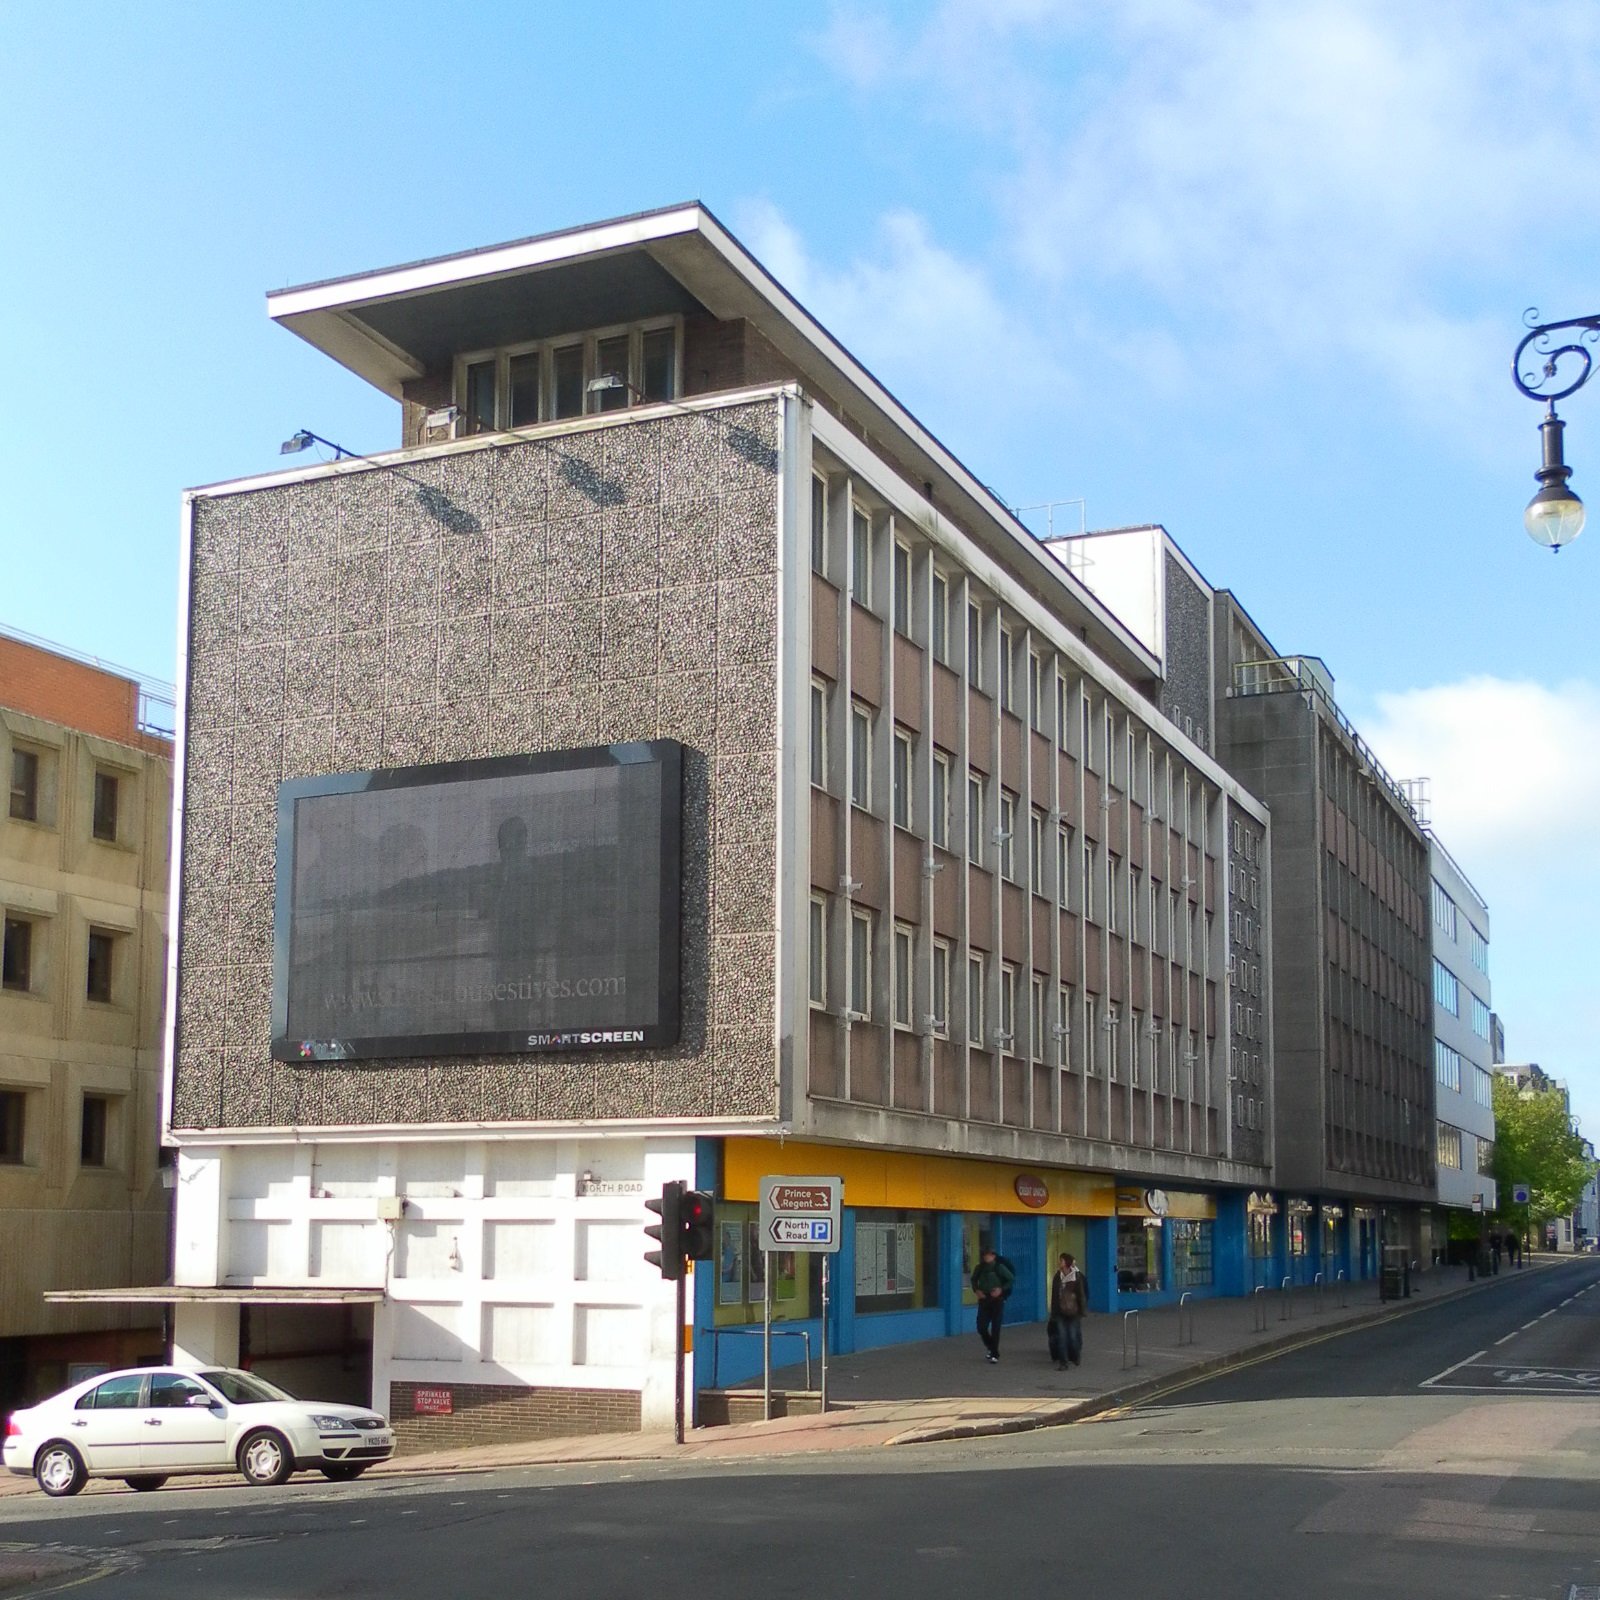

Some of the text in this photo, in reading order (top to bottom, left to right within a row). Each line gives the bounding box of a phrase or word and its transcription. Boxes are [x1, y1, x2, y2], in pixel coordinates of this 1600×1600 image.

[528, 1031, 644, 1046] SMARTSCREEN
[582, 1183, 643, 1193] NORTH ROAD
[784, 1189, 811, 1198] Prince
[782, 1199, 813, 1209] Regent
[784, 1221, 809, 1230] North
[786, 1231, 808, 1240] Road
[814, 1223, 826, 1239] P
[417, 1390, 451, 1398] SPRINKLER
[417, 1397, 451, 1406] STOP VALVE
